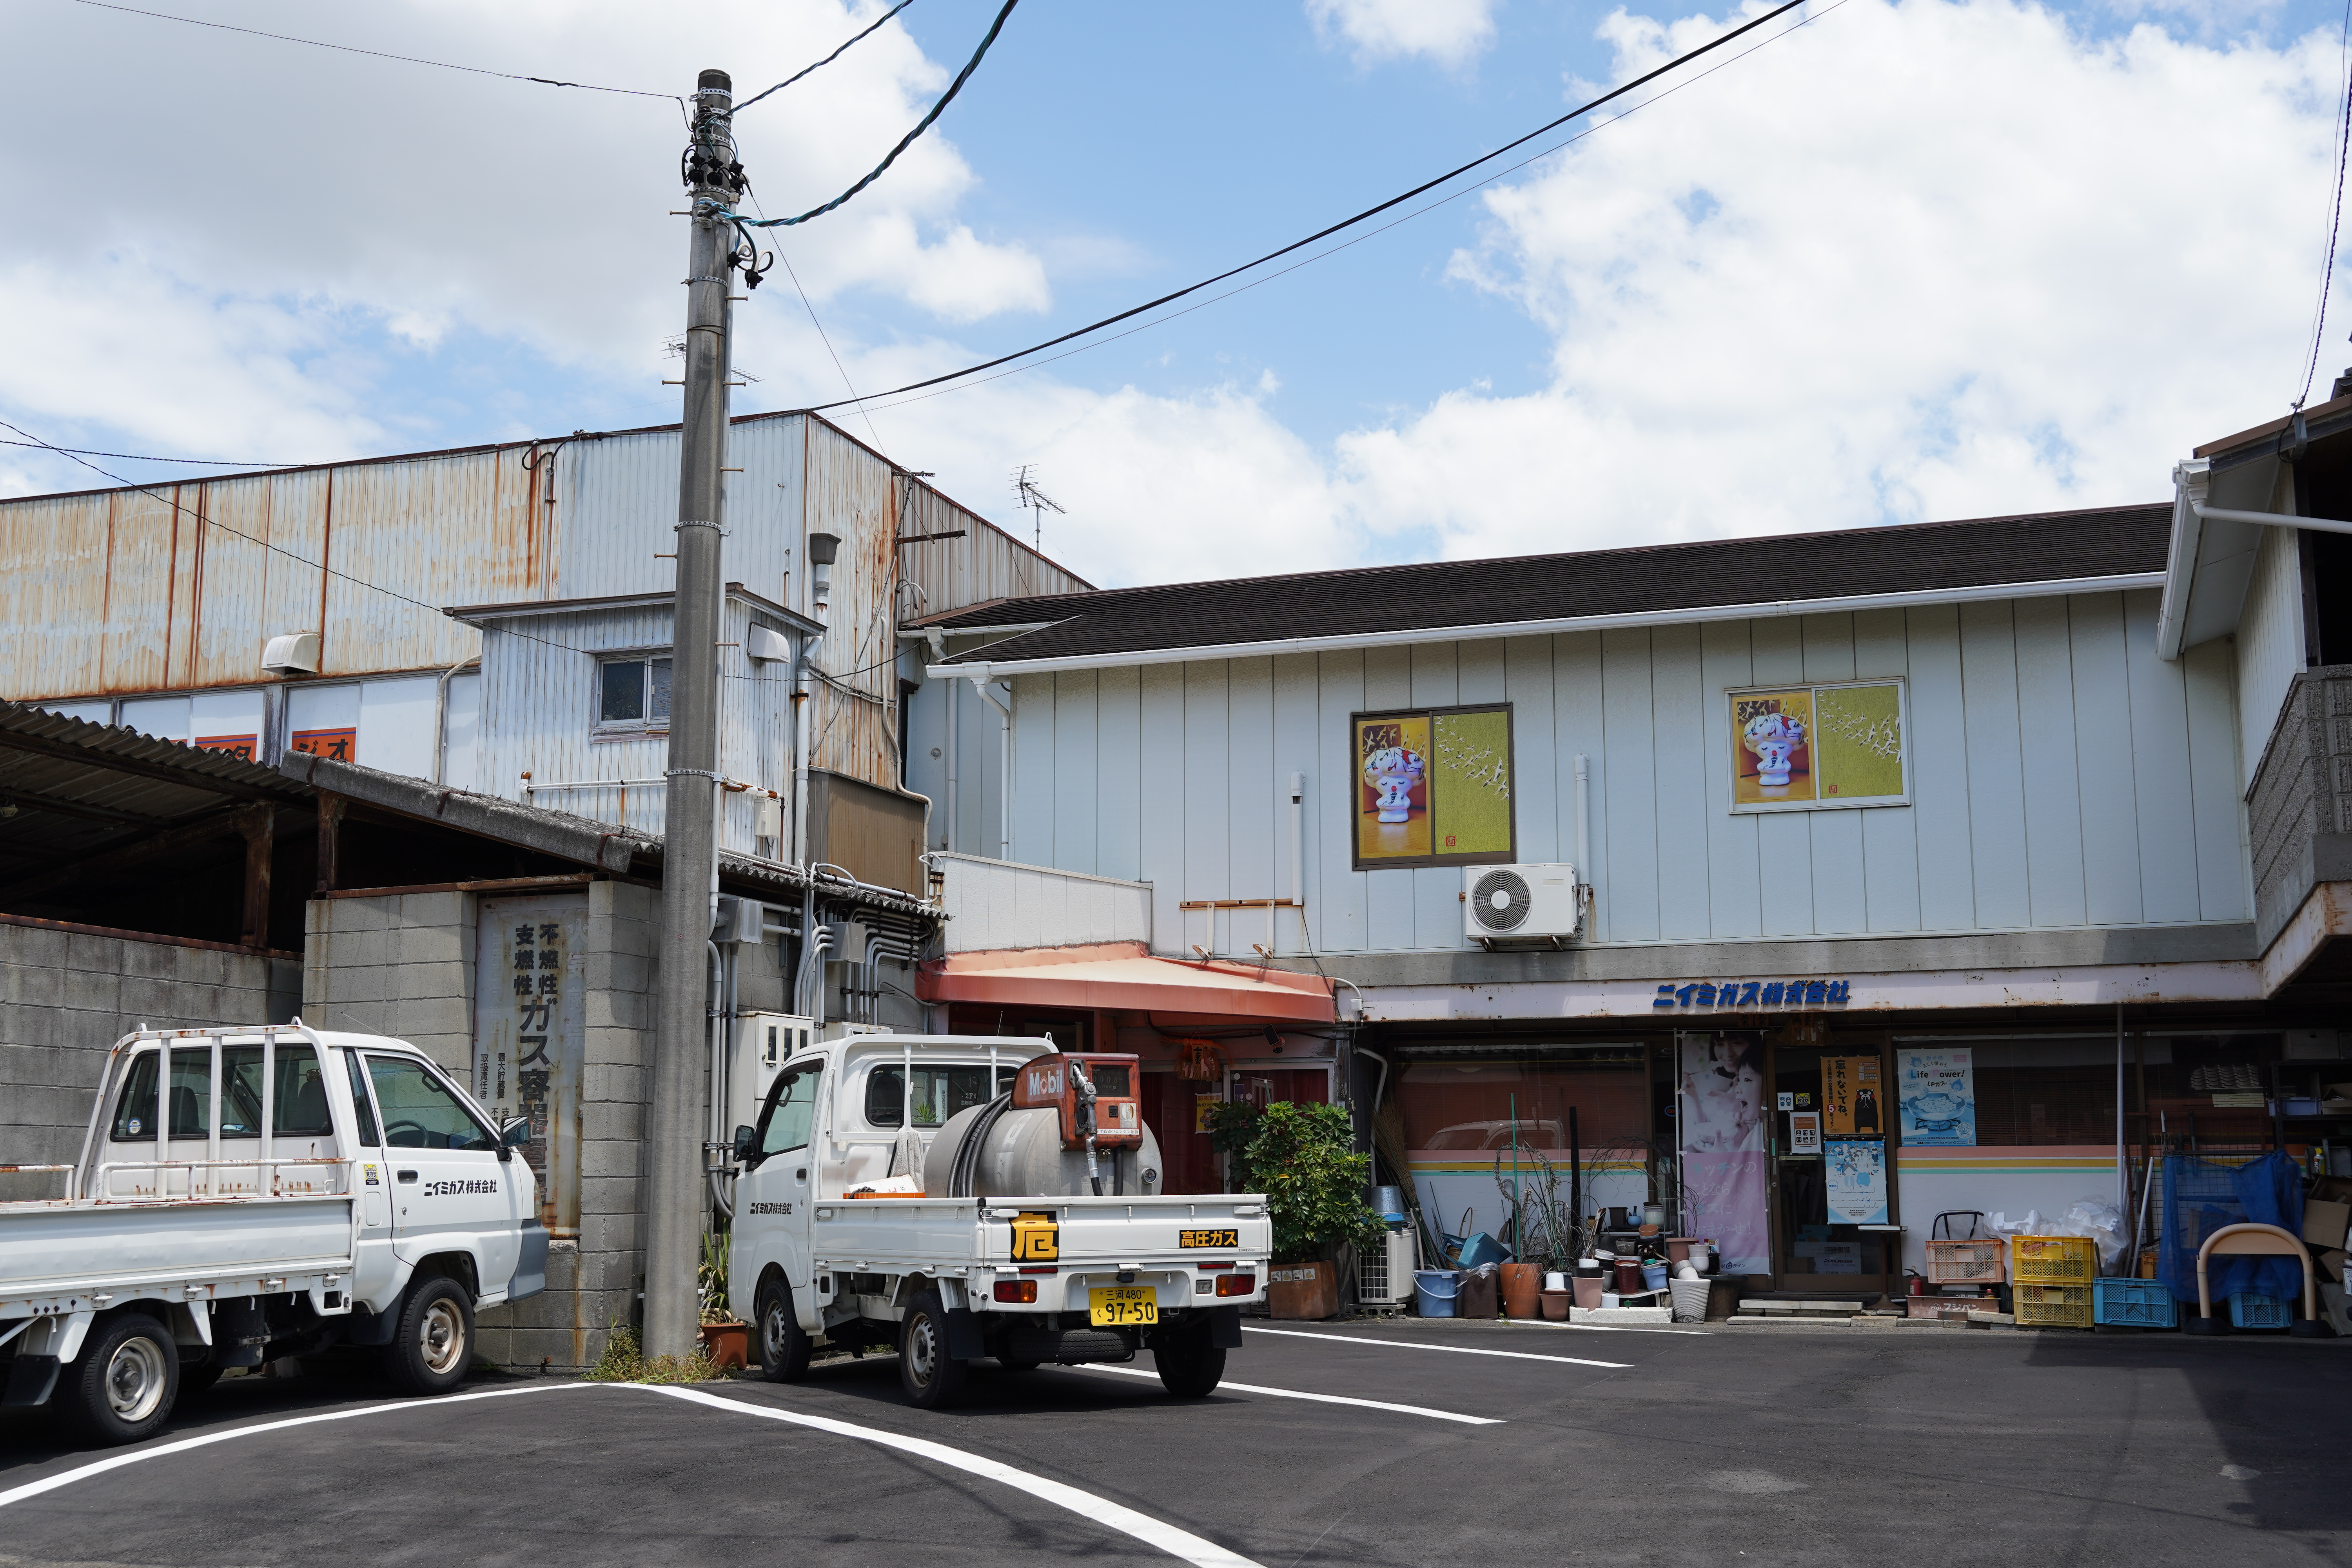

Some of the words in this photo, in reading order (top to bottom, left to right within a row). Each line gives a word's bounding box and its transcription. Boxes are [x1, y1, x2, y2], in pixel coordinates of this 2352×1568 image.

[514, 923, 534, 996] 支燃性
[539, 924, 559, 995] 不燃性
[1653, 980, 1850, 1007] ニイミガス株式会社
[479, 1054, 488, 1099] 取扱責任者
[497, 1053, 506, 1099] 最大貯蔵量
[1029, 1069, 1063, 1096] Mobil
[1911, 1070, 1929, 1078] Life
[1932, 1069, 1965, 1078] Power!
[1835, 1059, 1847, 1116] 忘れないでね。
[1691, 1161, 1757, 1176] キッチンの
[424, 1180, 497, 1196] ニイミガス株式会社
[1693, 1182, 1731, 1196] ことなら
[750, 1202, 792, 1215] ニイミガス株式会社
[1010, 1212, 1058, 1260] 危
[1181, 1230, 1237, 1247] 高圧ガス
[1106, 1290, 1124, 1300] 三河
[1125, 1289, 1142, 1299] 480
[1097, 1308, 1101, 1318] く
[1105, 1302, 1154, 1322] 97-50
[1943, 1303, 1980, 1311] フジパン
